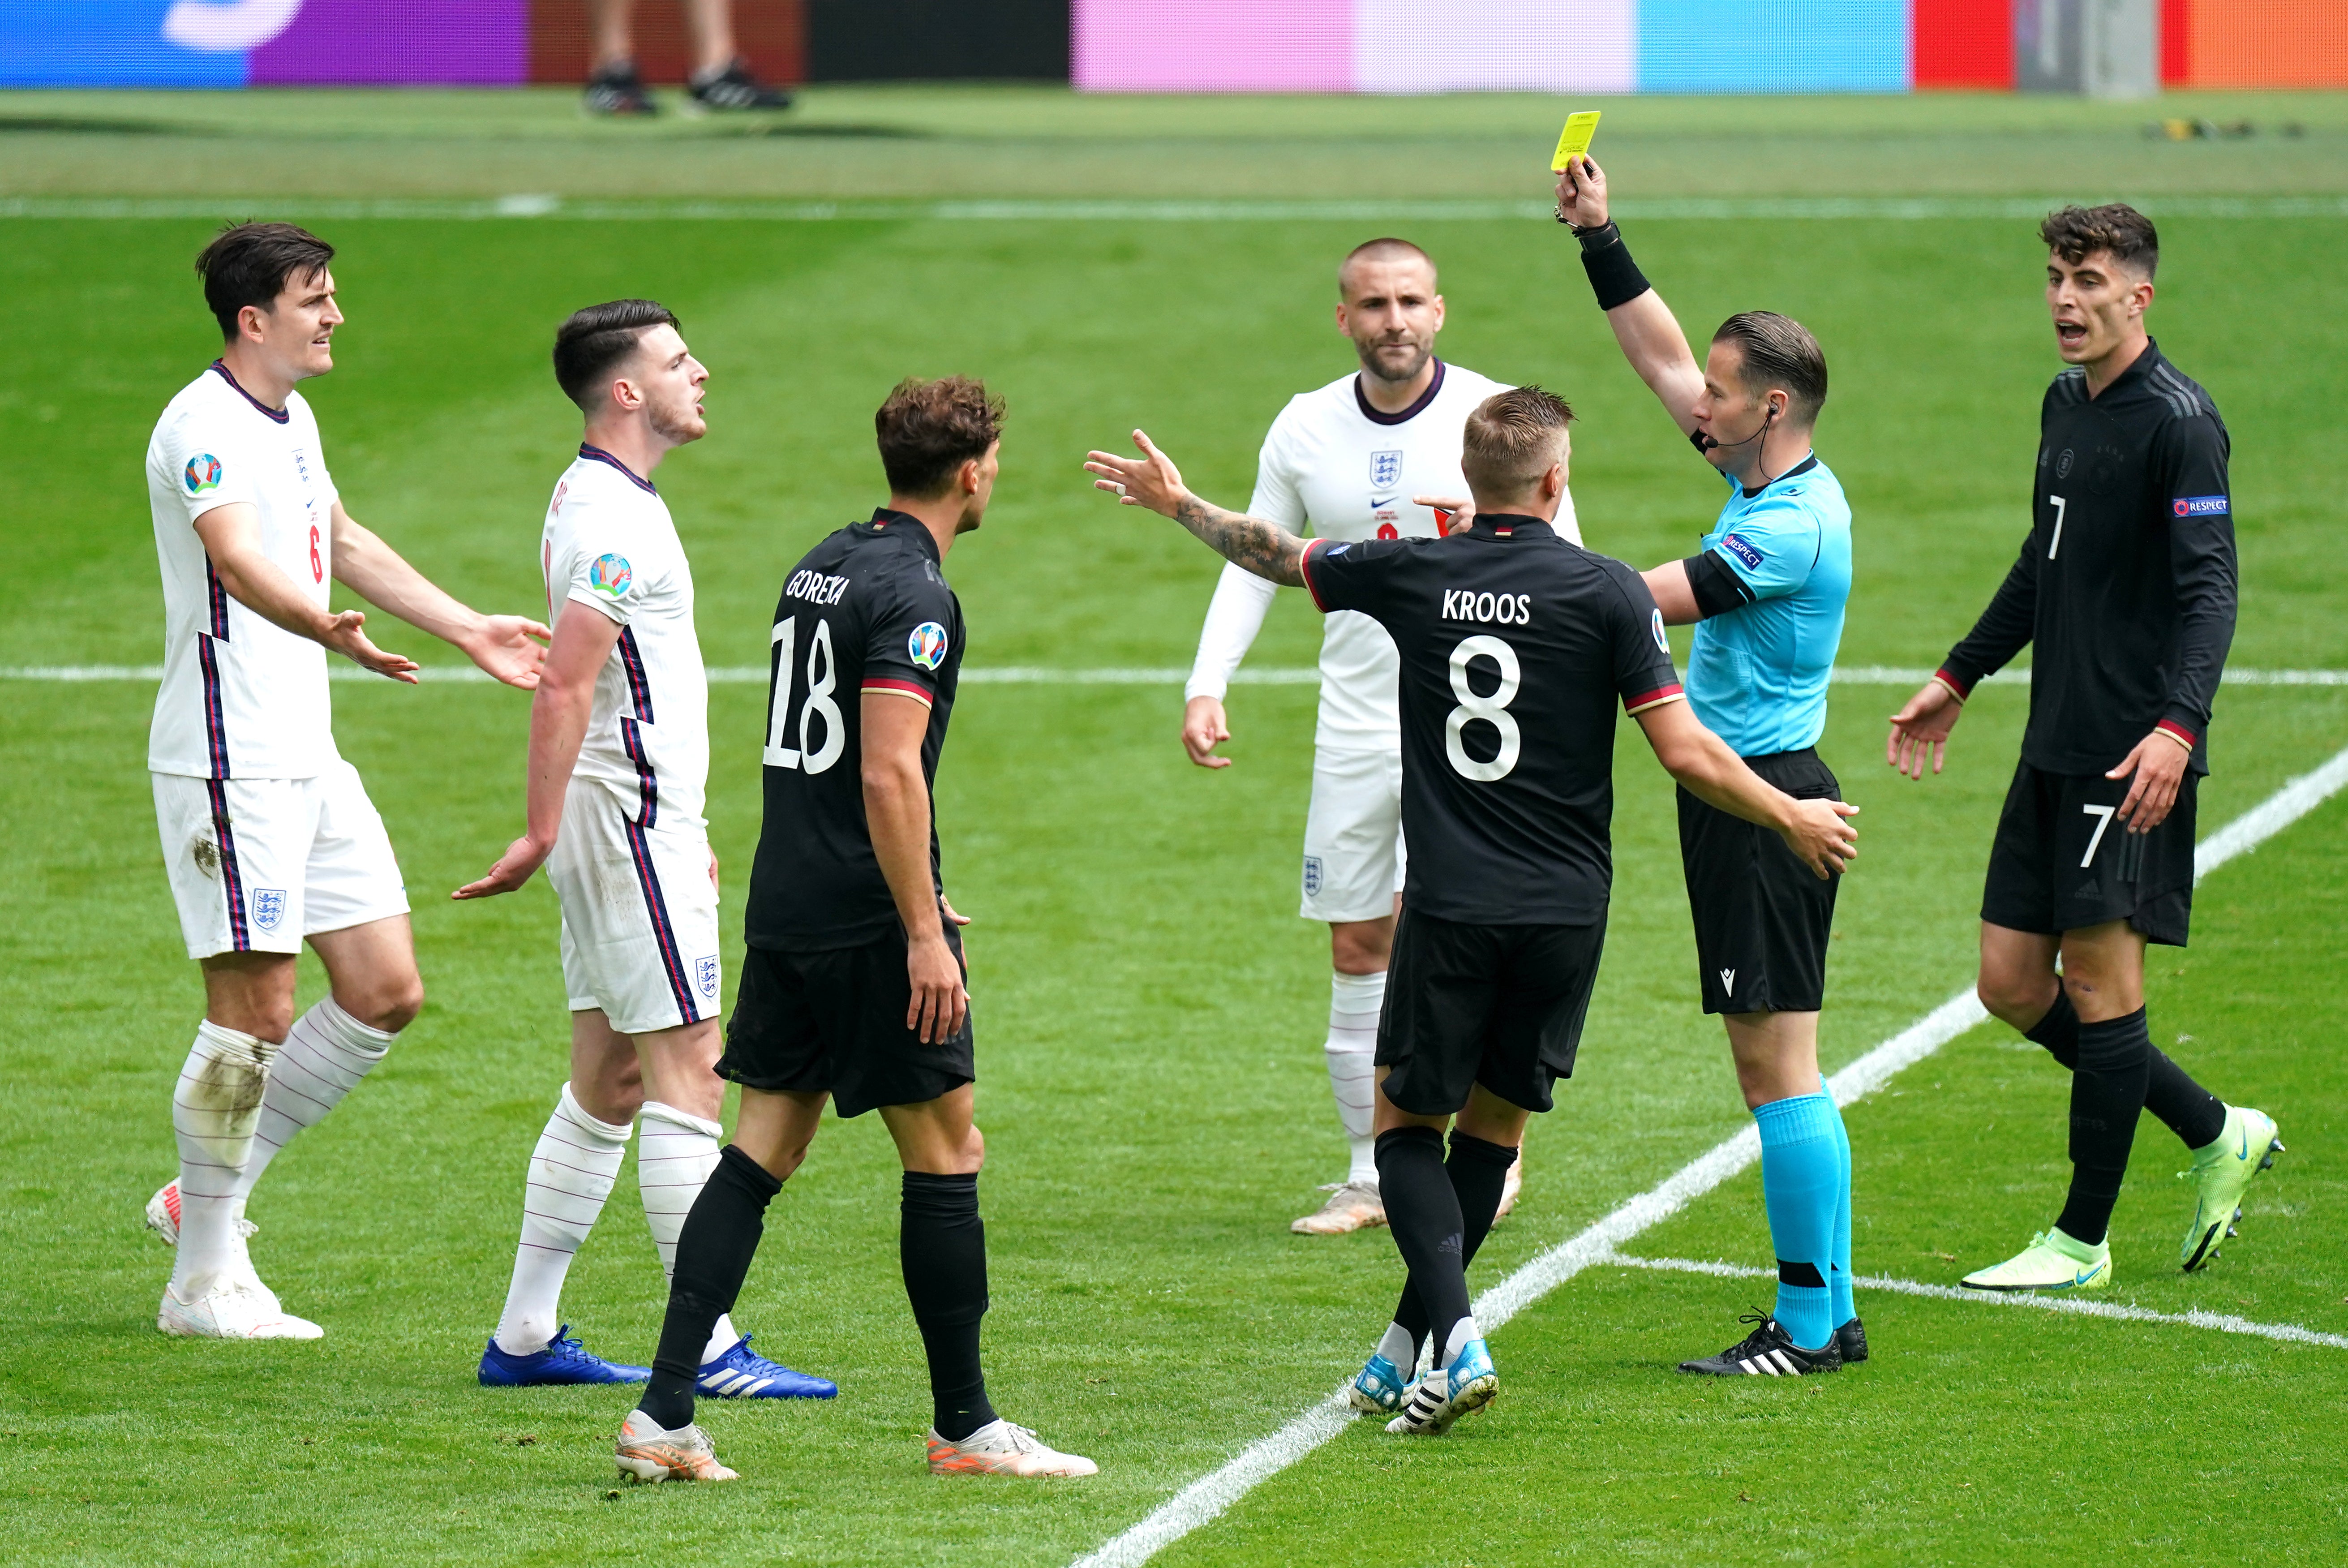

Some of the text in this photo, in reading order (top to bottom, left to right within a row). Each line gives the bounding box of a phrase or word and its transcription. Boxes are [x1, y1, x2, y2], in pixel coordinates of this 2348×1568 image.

[2048, 495, 2065, 560] 7
[2189, 500, 2227, 511] RESPECT
[309, 524, 322, 584] 6
[1728, 539, 1760, 566] RESPECT
[1442, 589, 1530, 625] KROOS
[763, 615, 845, 775] 18
[1446, 635, 1521, 782] 8
[2080, 803, 2116, 868] 7
